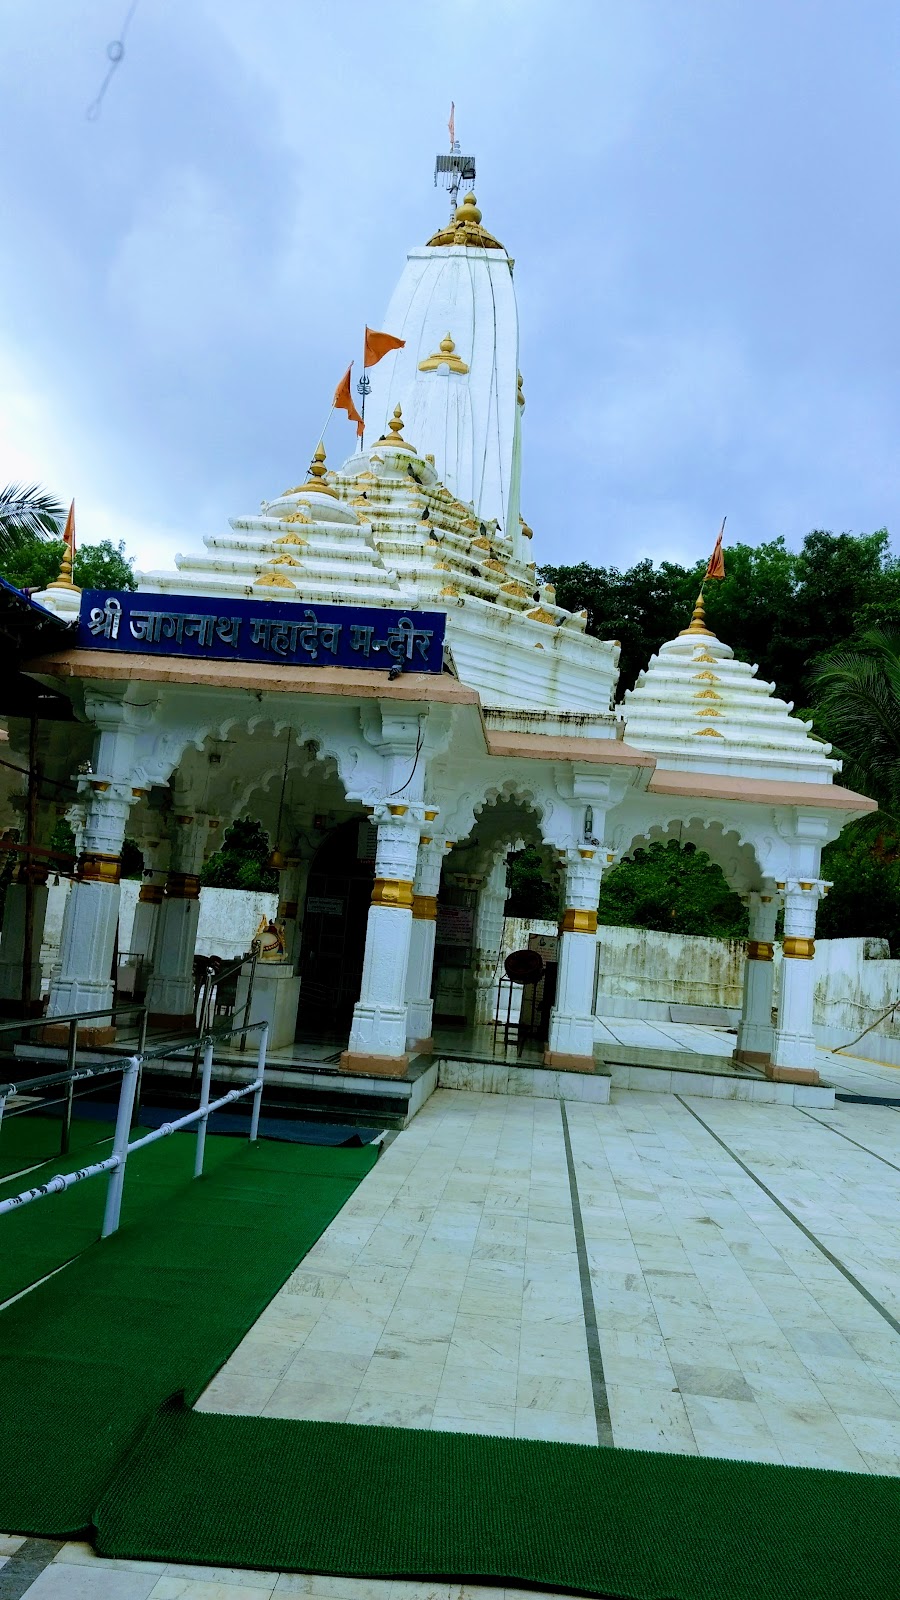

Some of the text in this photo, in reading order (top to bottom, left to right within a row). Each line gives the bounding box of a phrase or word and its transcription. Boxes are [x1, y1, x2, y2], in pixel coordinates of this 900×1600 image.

[87, 597, 122, 640] श्री
[129, 610, 242, 648] जागनाथ
[250, 609, 342, 659] महादेव
